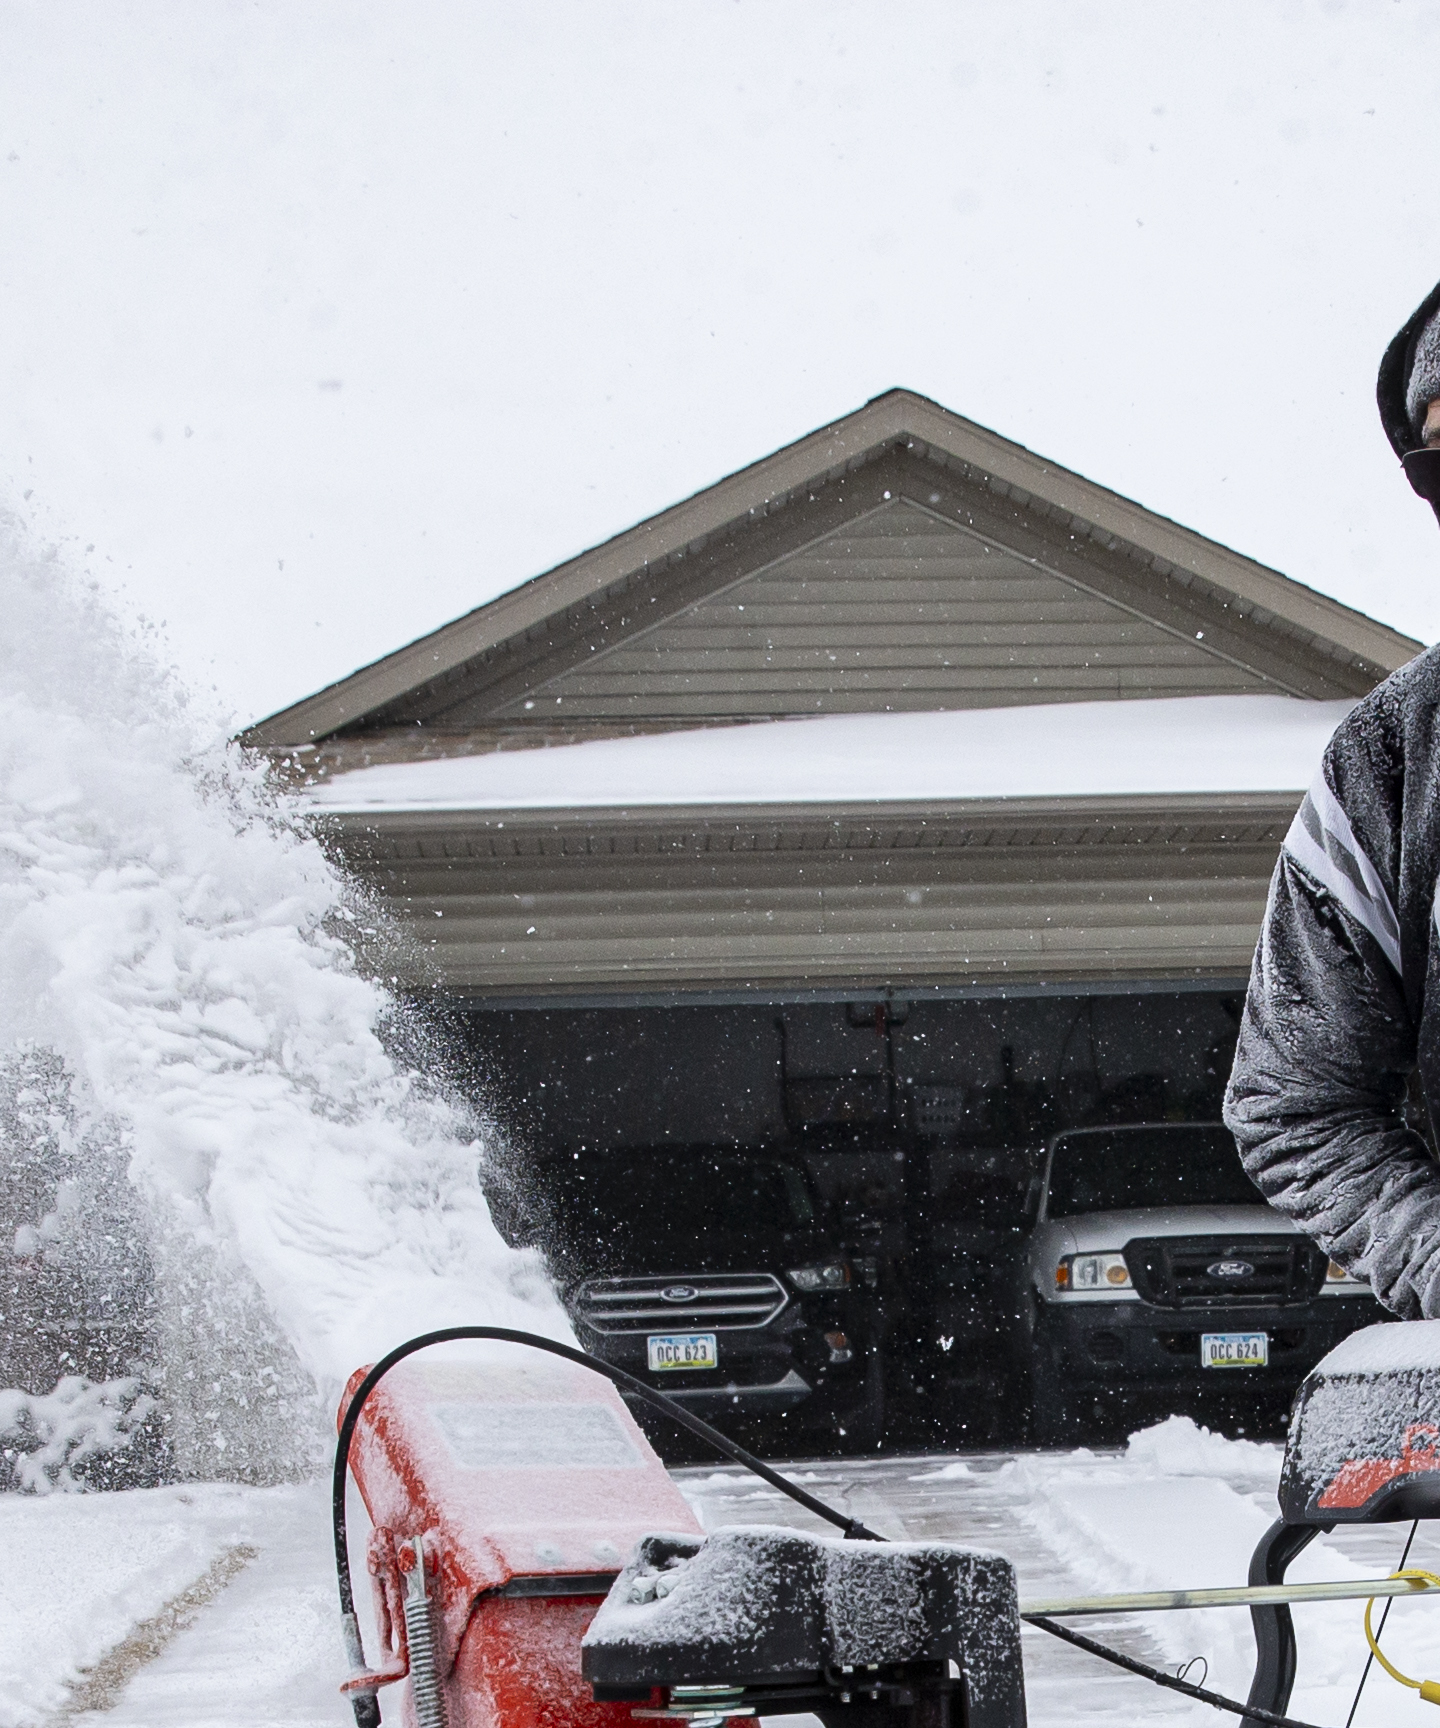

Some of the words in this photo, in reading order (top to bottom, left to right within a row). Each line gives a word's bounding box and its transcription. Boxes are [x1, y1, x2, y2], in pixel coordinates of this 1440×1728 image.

[684, 1344, 707, 1361] 623
[1210, 1343, 1233, 1360] OCC
[1236, 1342, 1259, 1359] 624
